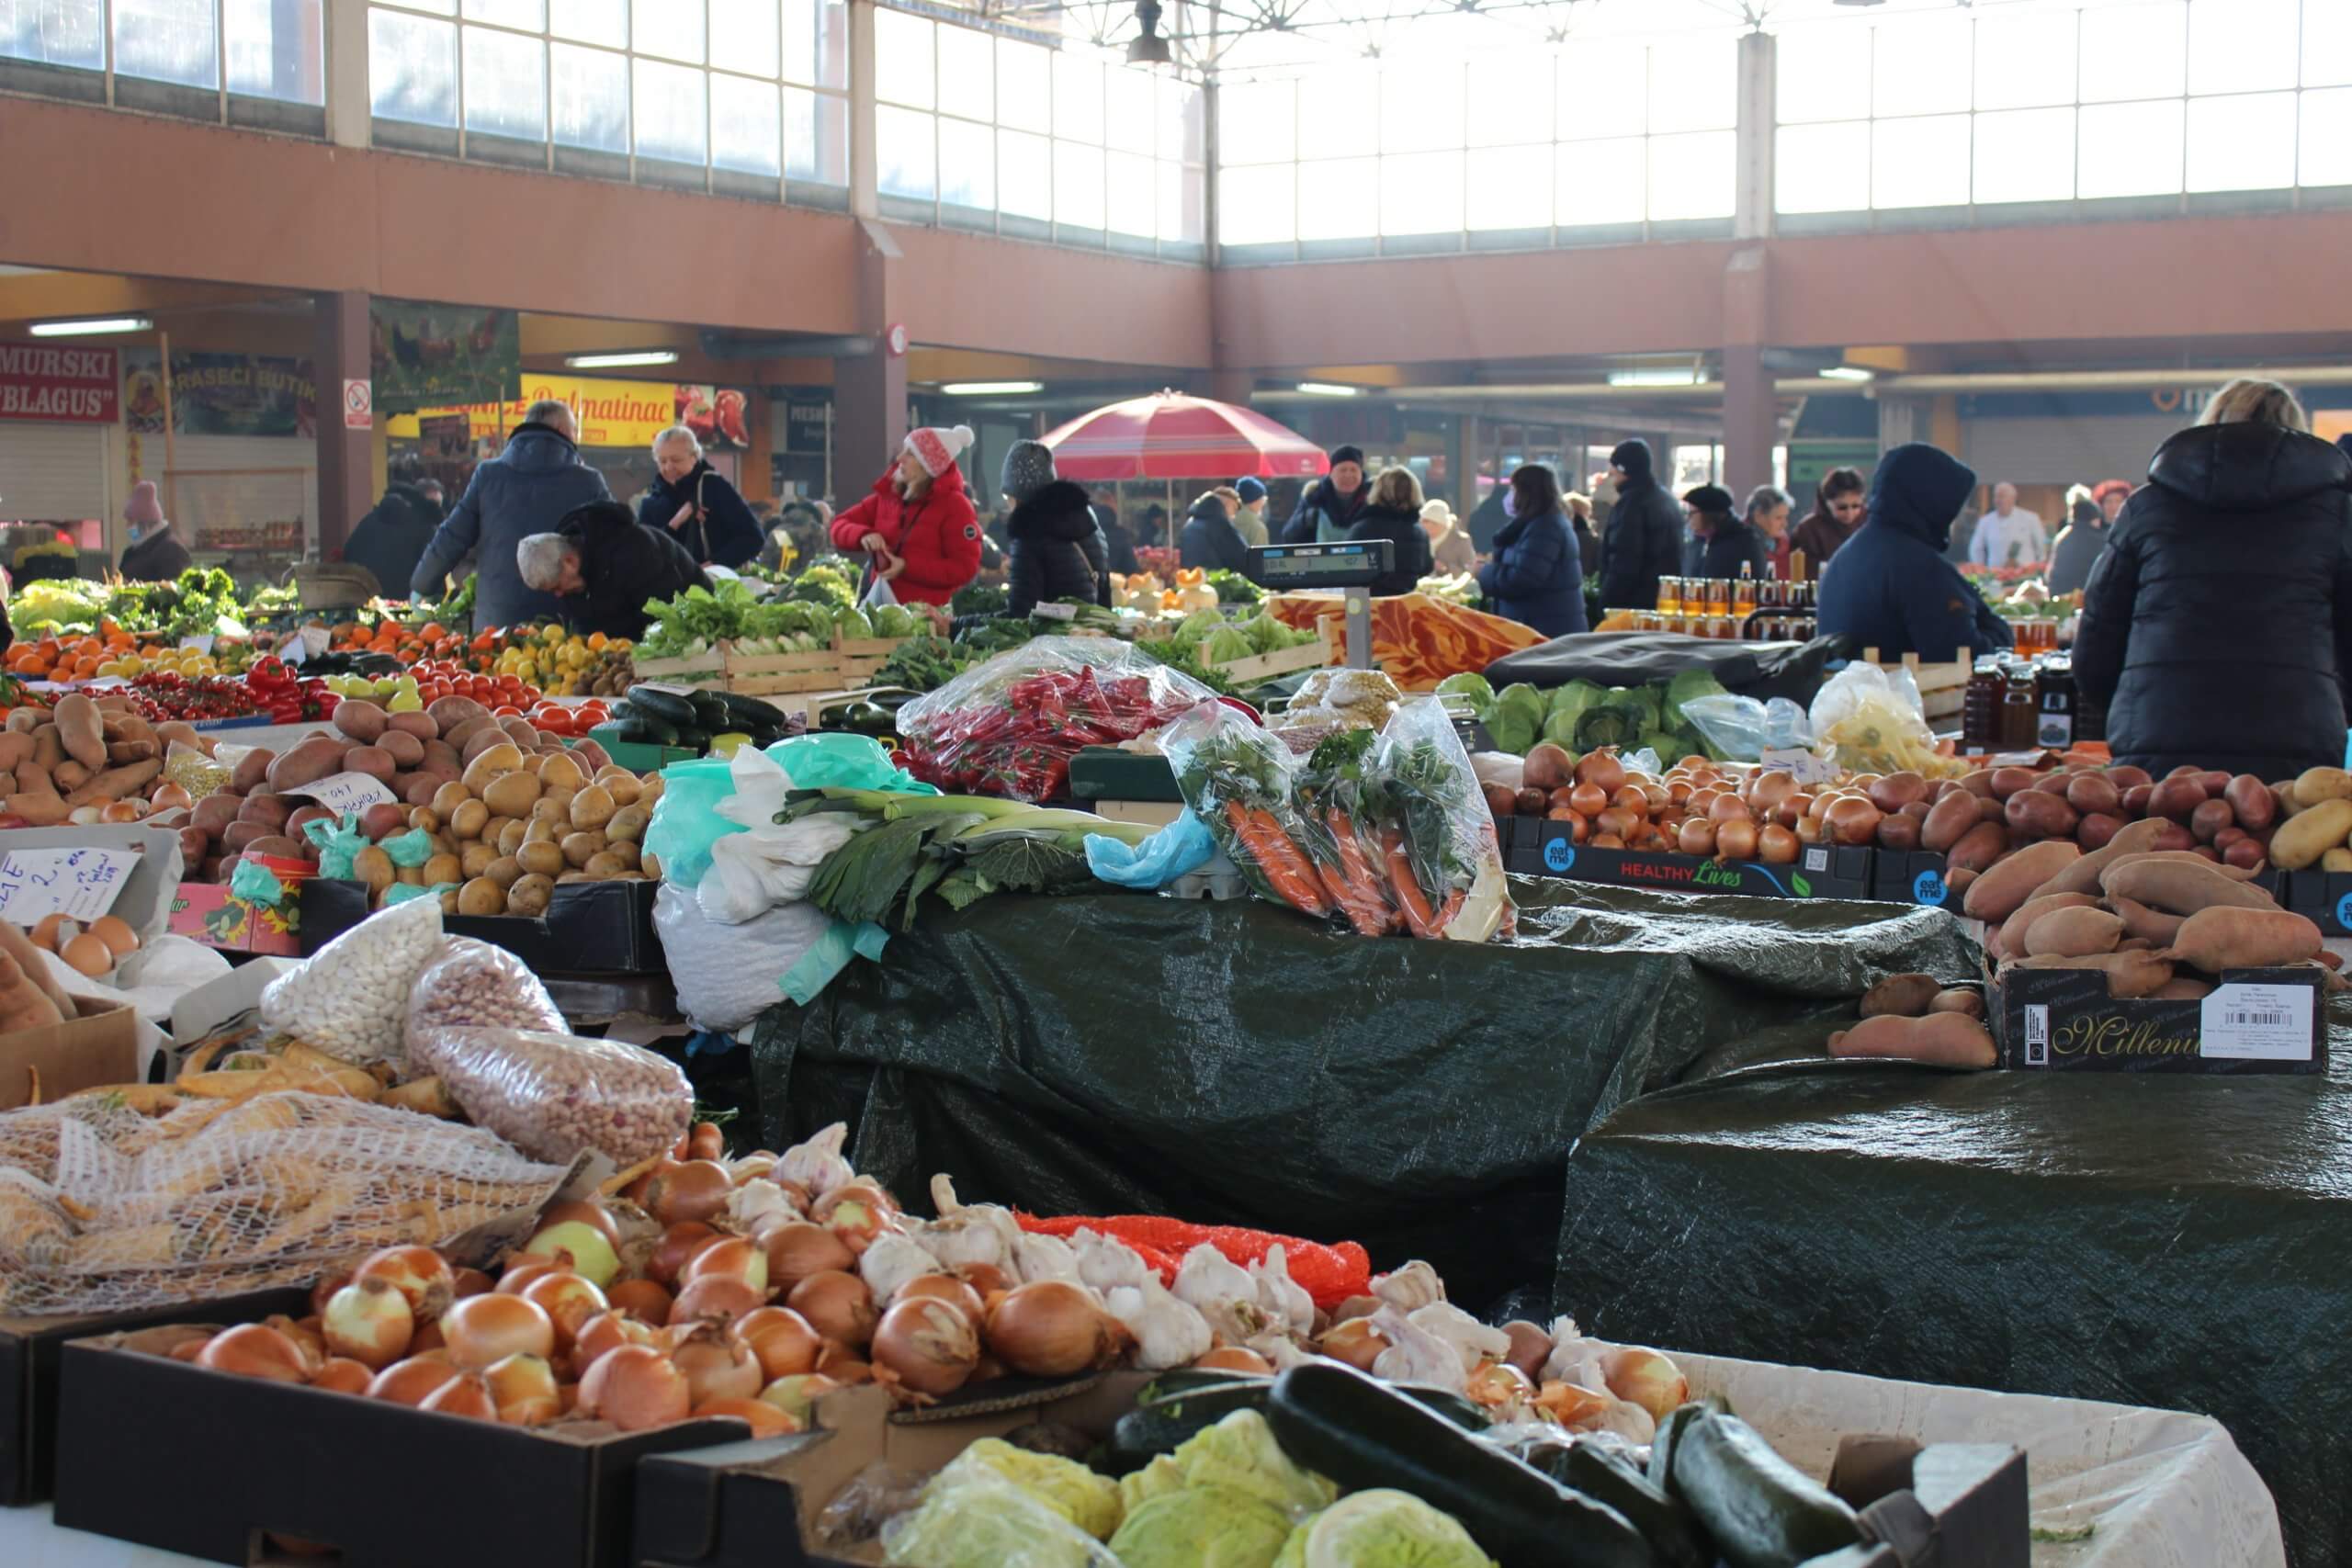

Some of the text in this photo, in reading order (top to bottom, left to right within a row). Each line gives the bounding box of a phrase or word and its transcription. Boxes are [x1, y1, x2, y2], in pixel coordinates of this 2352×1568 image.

[0, 348, 111, 378] MURSKI
[533, 387, 669, 423] lmatinac
[1549, 844, 1569, 855] eat
[1549, 853, 1569, 863] me
[1622, 860, 1742, 887] HEALTHY Lives
[1920, 878, 1942, 891] eat
[1919, 889, 1943, 899] me
